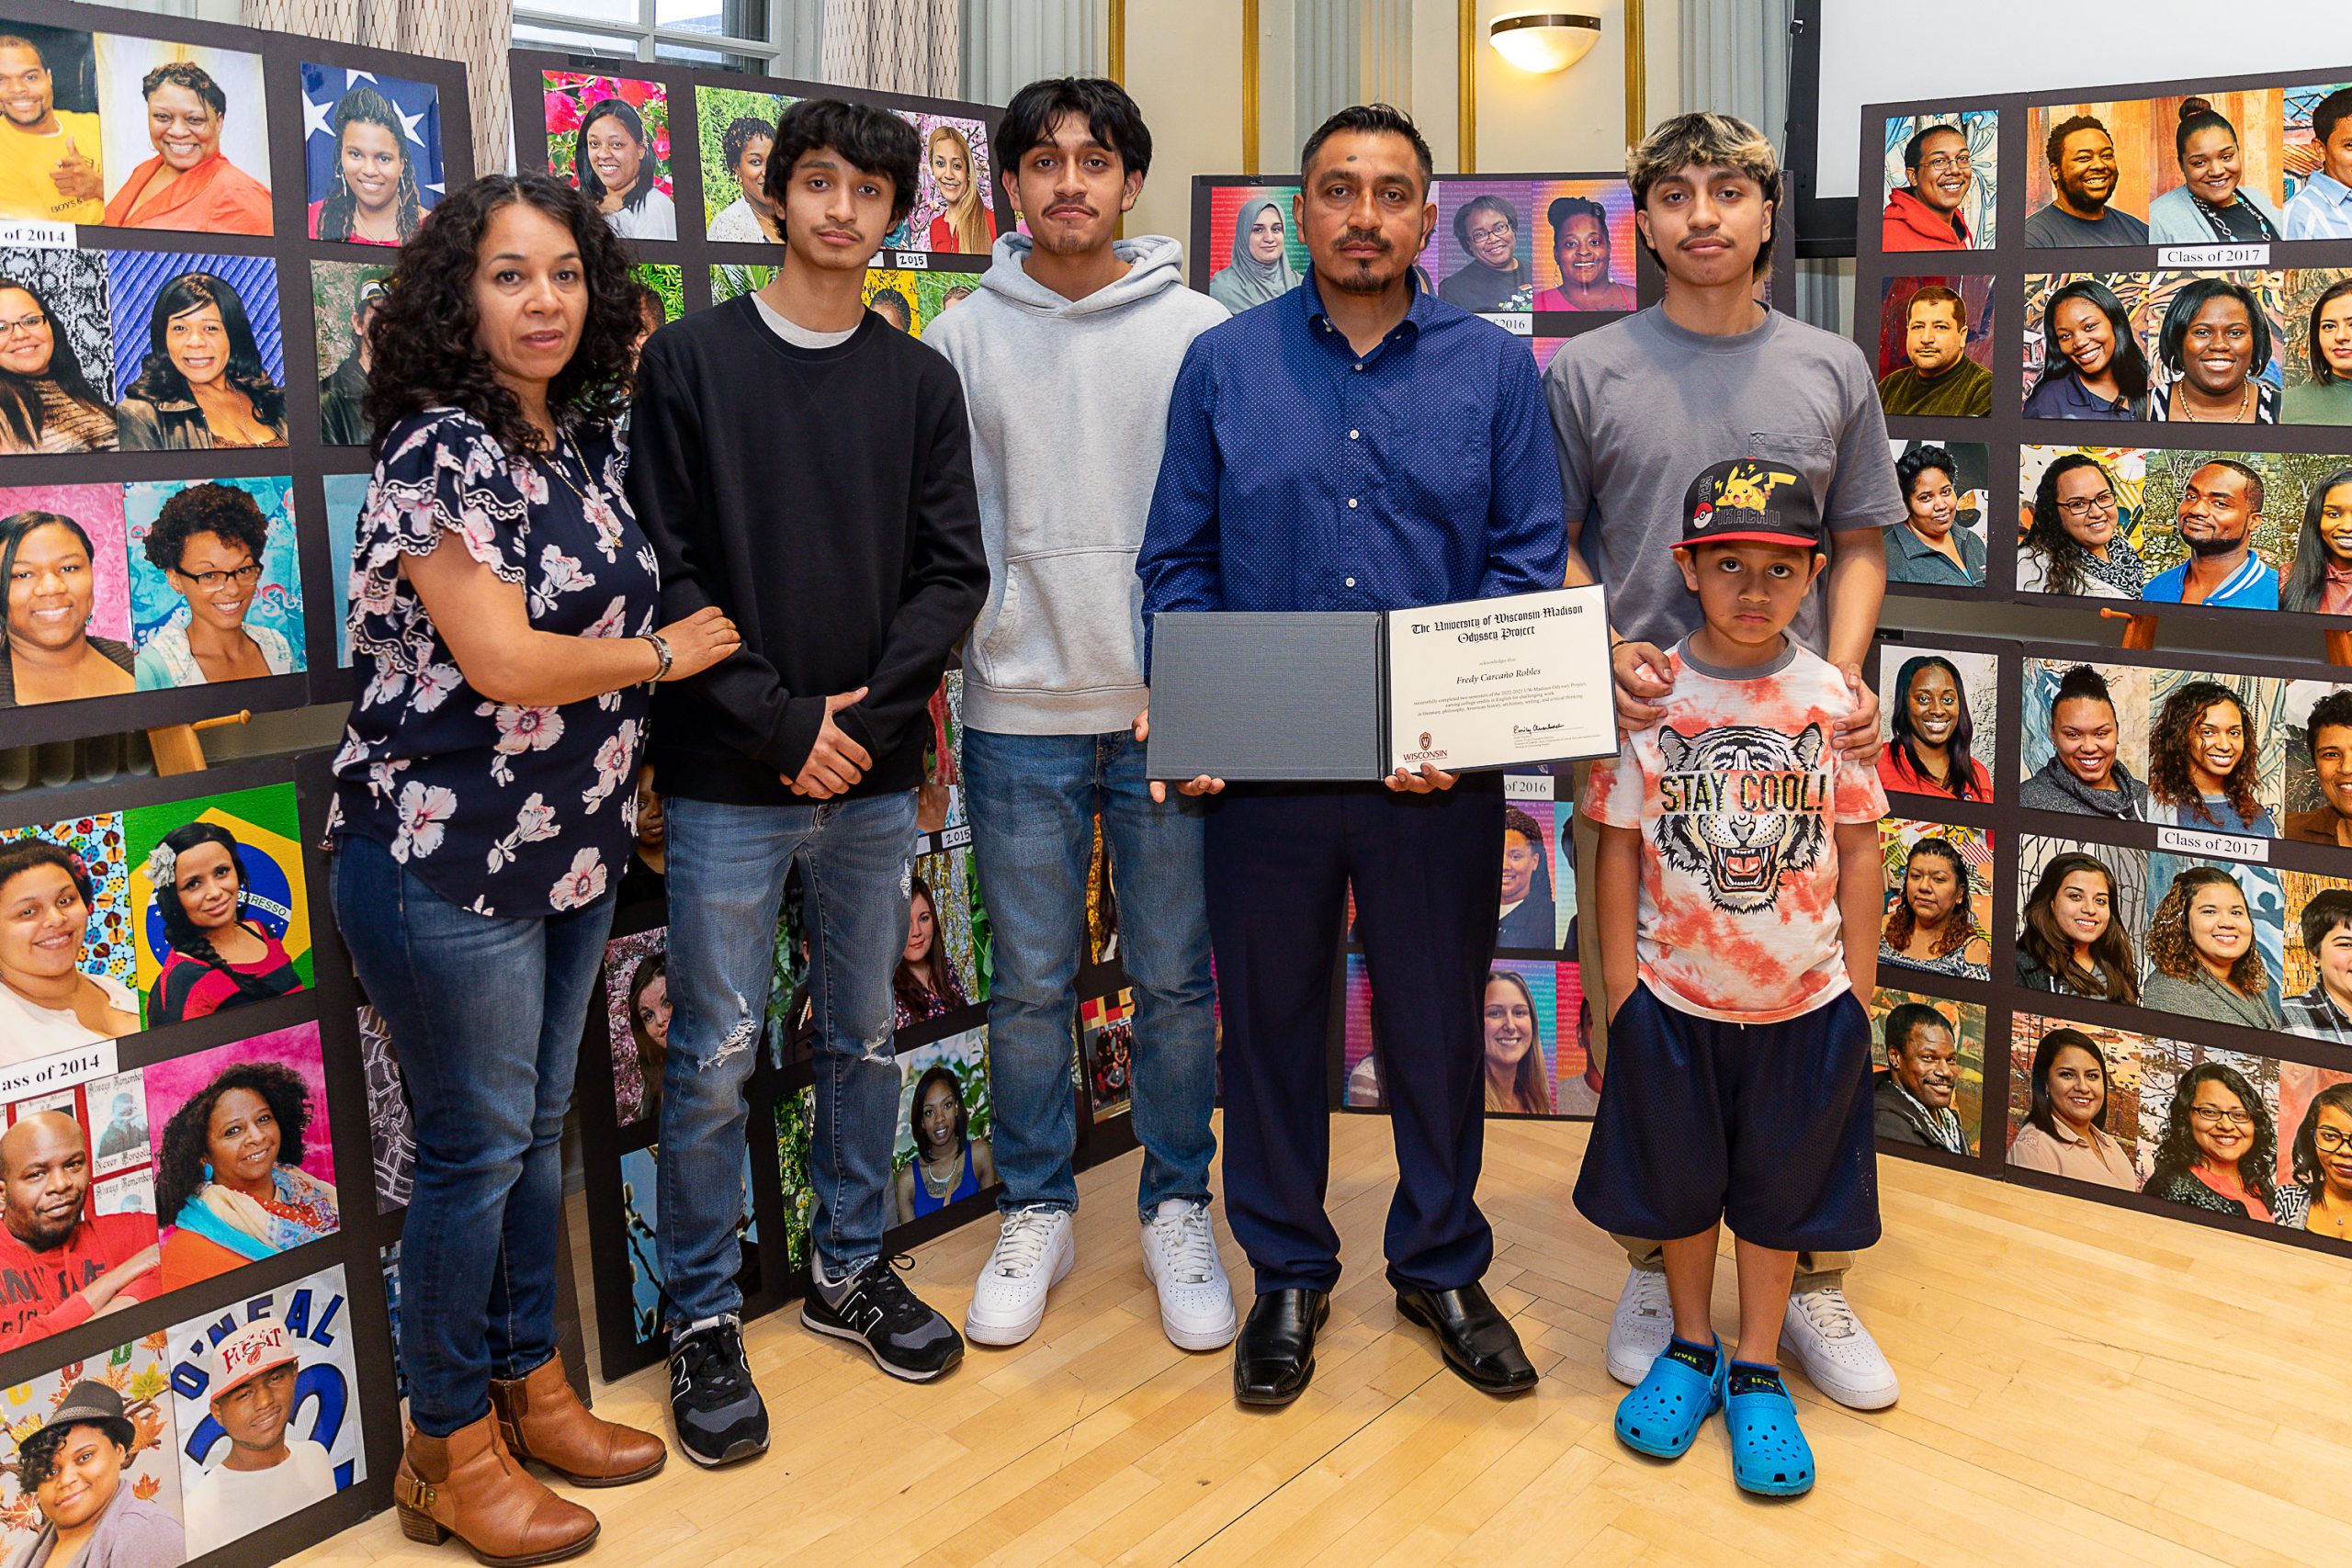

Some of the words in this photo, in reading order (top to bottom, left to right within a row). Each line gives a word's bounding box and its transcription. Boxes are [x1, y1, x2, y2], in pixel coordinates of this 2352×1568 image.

[51, 199, 76, 213] BOYS
[5, 229, 22, 241] of
[28, 230, 65, 243] 2014
[899, 255, 924, 266] 2015
[2167, 251, 2203, 263] Class
[2208, 251, 2223, 262] of
[2226, 249, 2260, 261] 2017
[1711, 507, 1781, 527] PIKACHU
[1411, 625, 1430, 635] The
[1434, 618, 1480, 631] University
[1483, 615, 1492, 626] of
[1494, 605, 1583, 624] Wisconsin-Madison
[1458, 631, 1498, 644] Odyssey
[1501, 626, 1535, 640] Project
[1456, 674, 1478, 684] Fredy
[1516, 668, 1541, 678] Robles
[1403, 750, 1448, 761] WISCONSIN
[1505, 781, 1517, 792] of
[1520, 781, 1546, 793] 2016
[1659, 773, 1730, 812] STAY
[1740, 773, 1826, 812] COOL!
[946, 829, 970, 844] 2015
[2165, 831, 2200, 848] Class
[2205, 839, 2222, 851] of
[2224, 840, 2259, 855] 2017
[2, 1075, 30, 1092] ass
[36, 1065, 55, 1083] of
[60, 1054, 100, 1077] 2014
